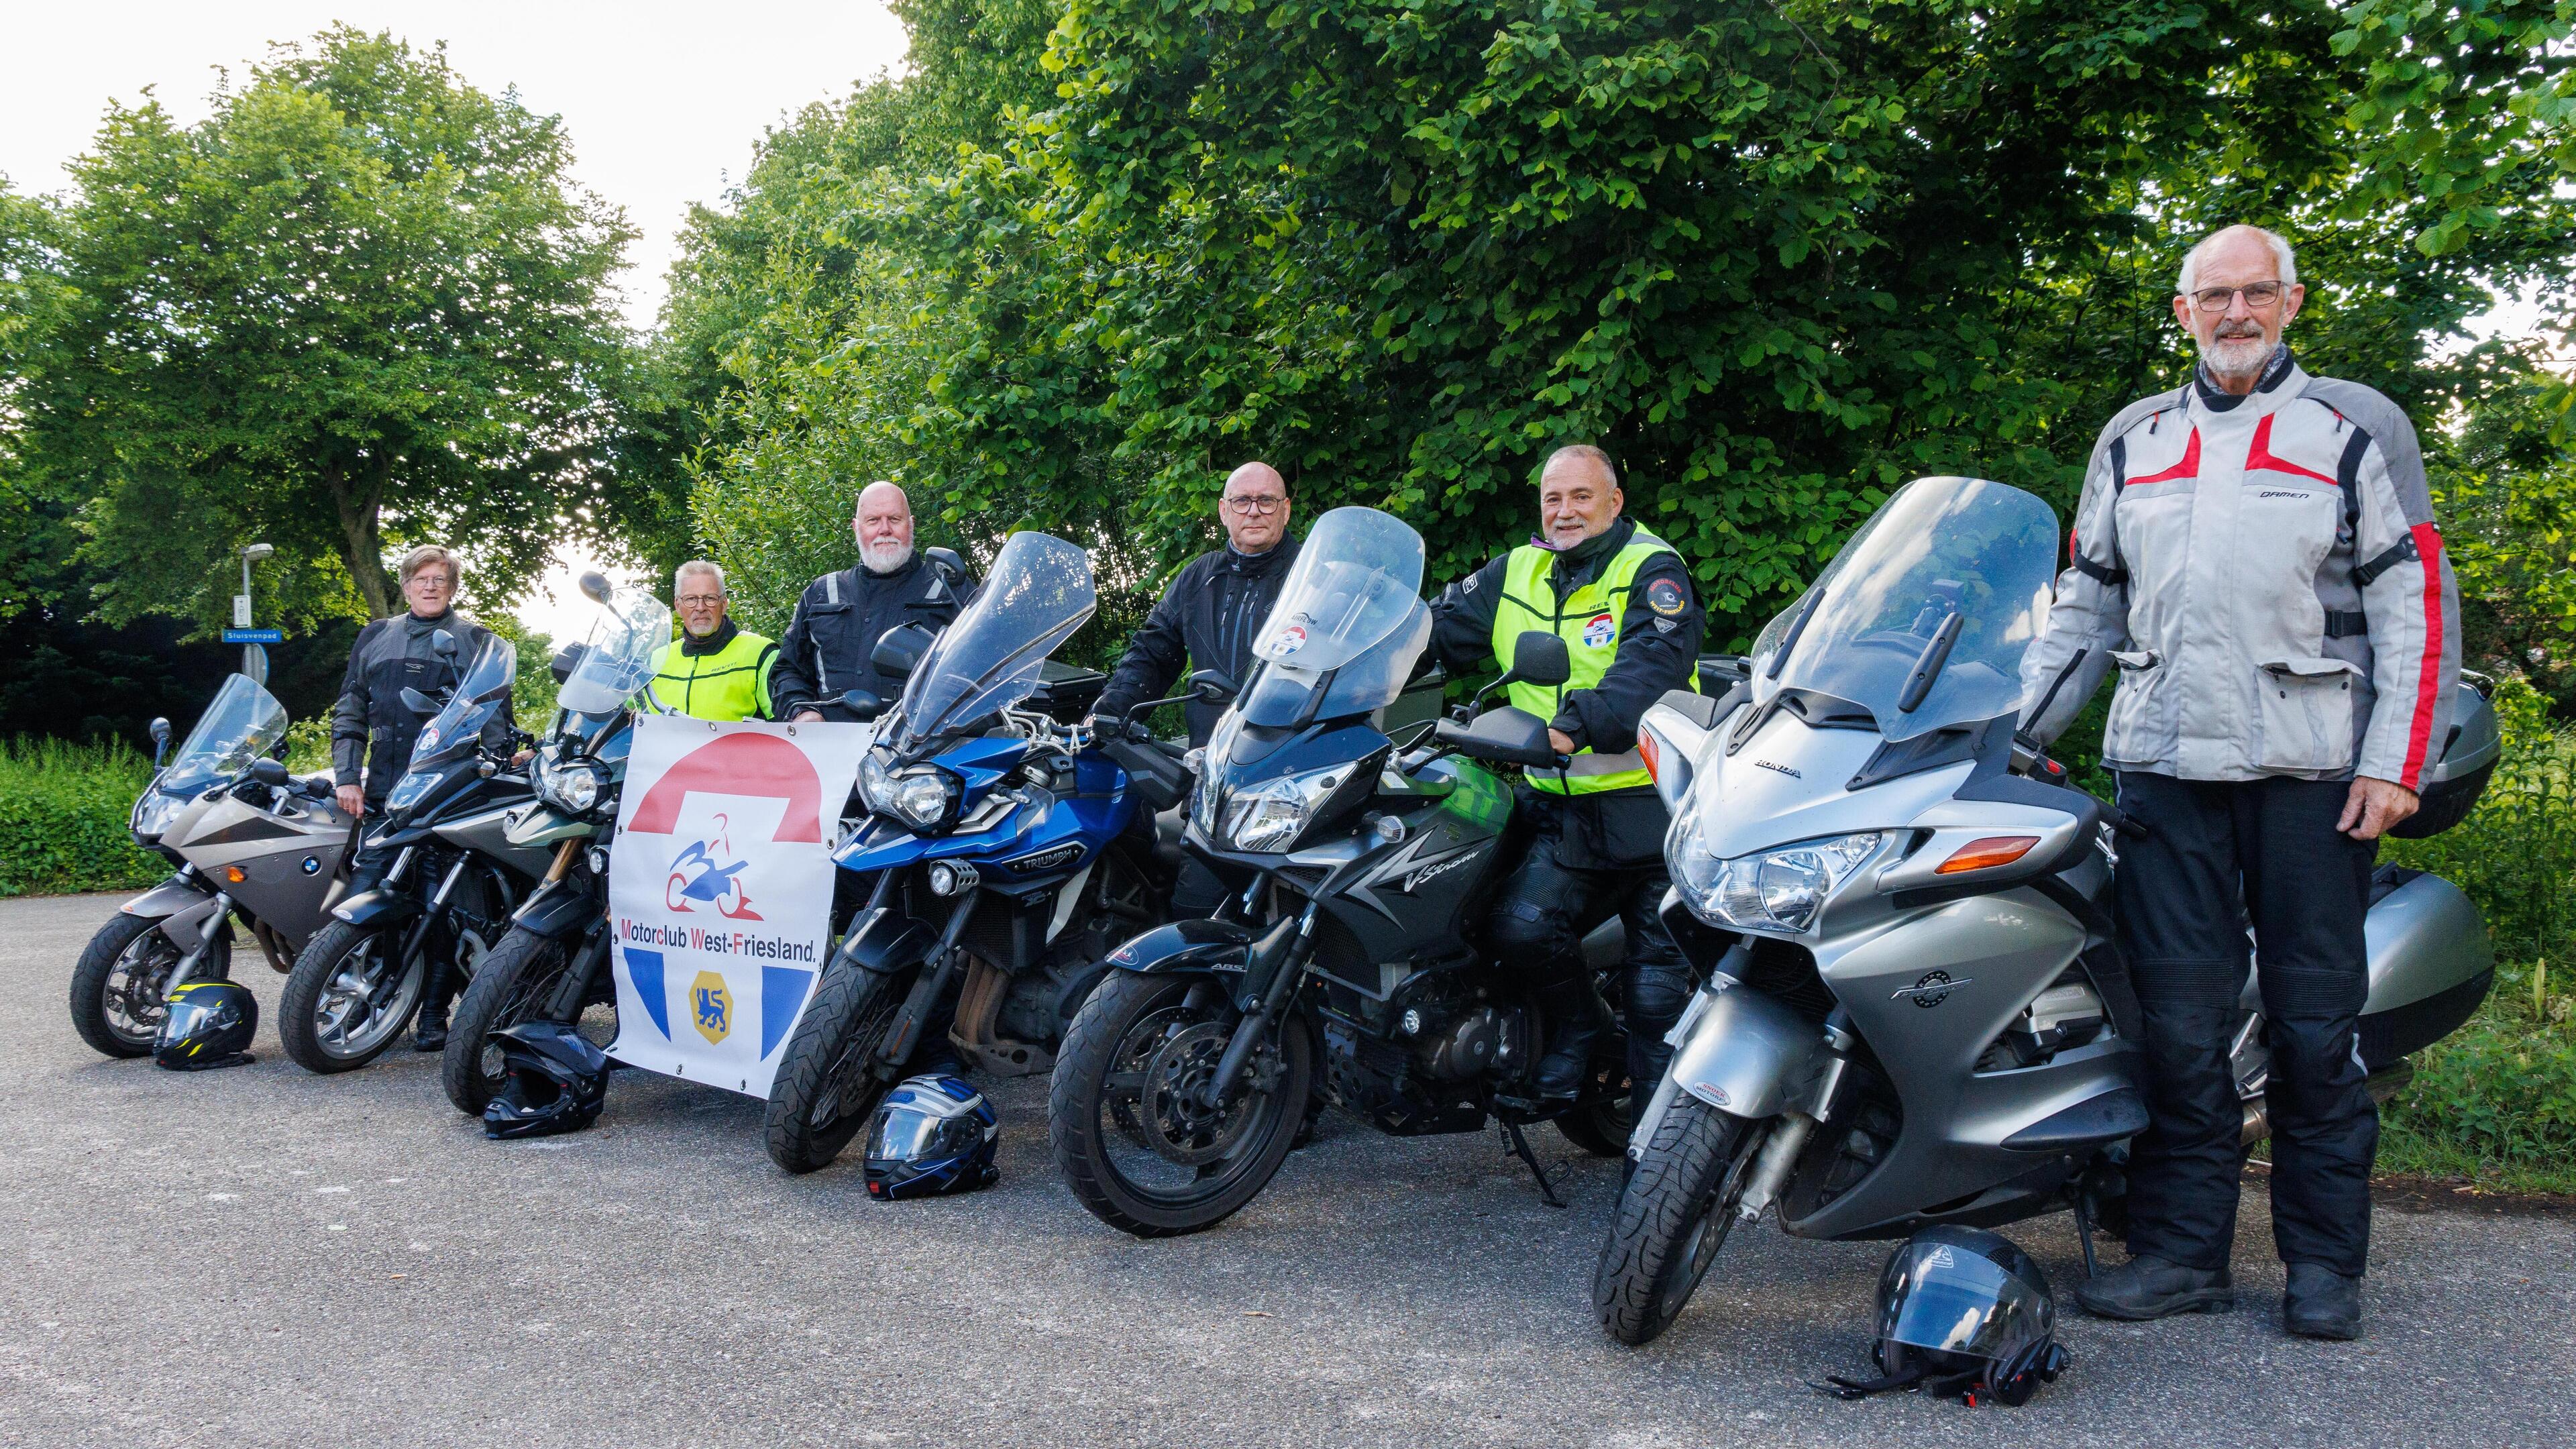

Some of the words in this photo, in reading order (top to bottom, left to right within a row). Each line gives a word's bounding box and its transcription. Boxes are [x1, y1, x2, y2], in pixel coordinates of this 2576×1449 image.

[227, 633, 277, 641] Sluisvenpad
[1755, 759, 1801, 779] HONDA
[1024, 849, 1072, 869] TRIUMPH
[621, 918, 687, 948] Motorclub
[690, 928, 816, 963] West-Friesland.
[1702, 1083, 1726, 1097] SNOEK
